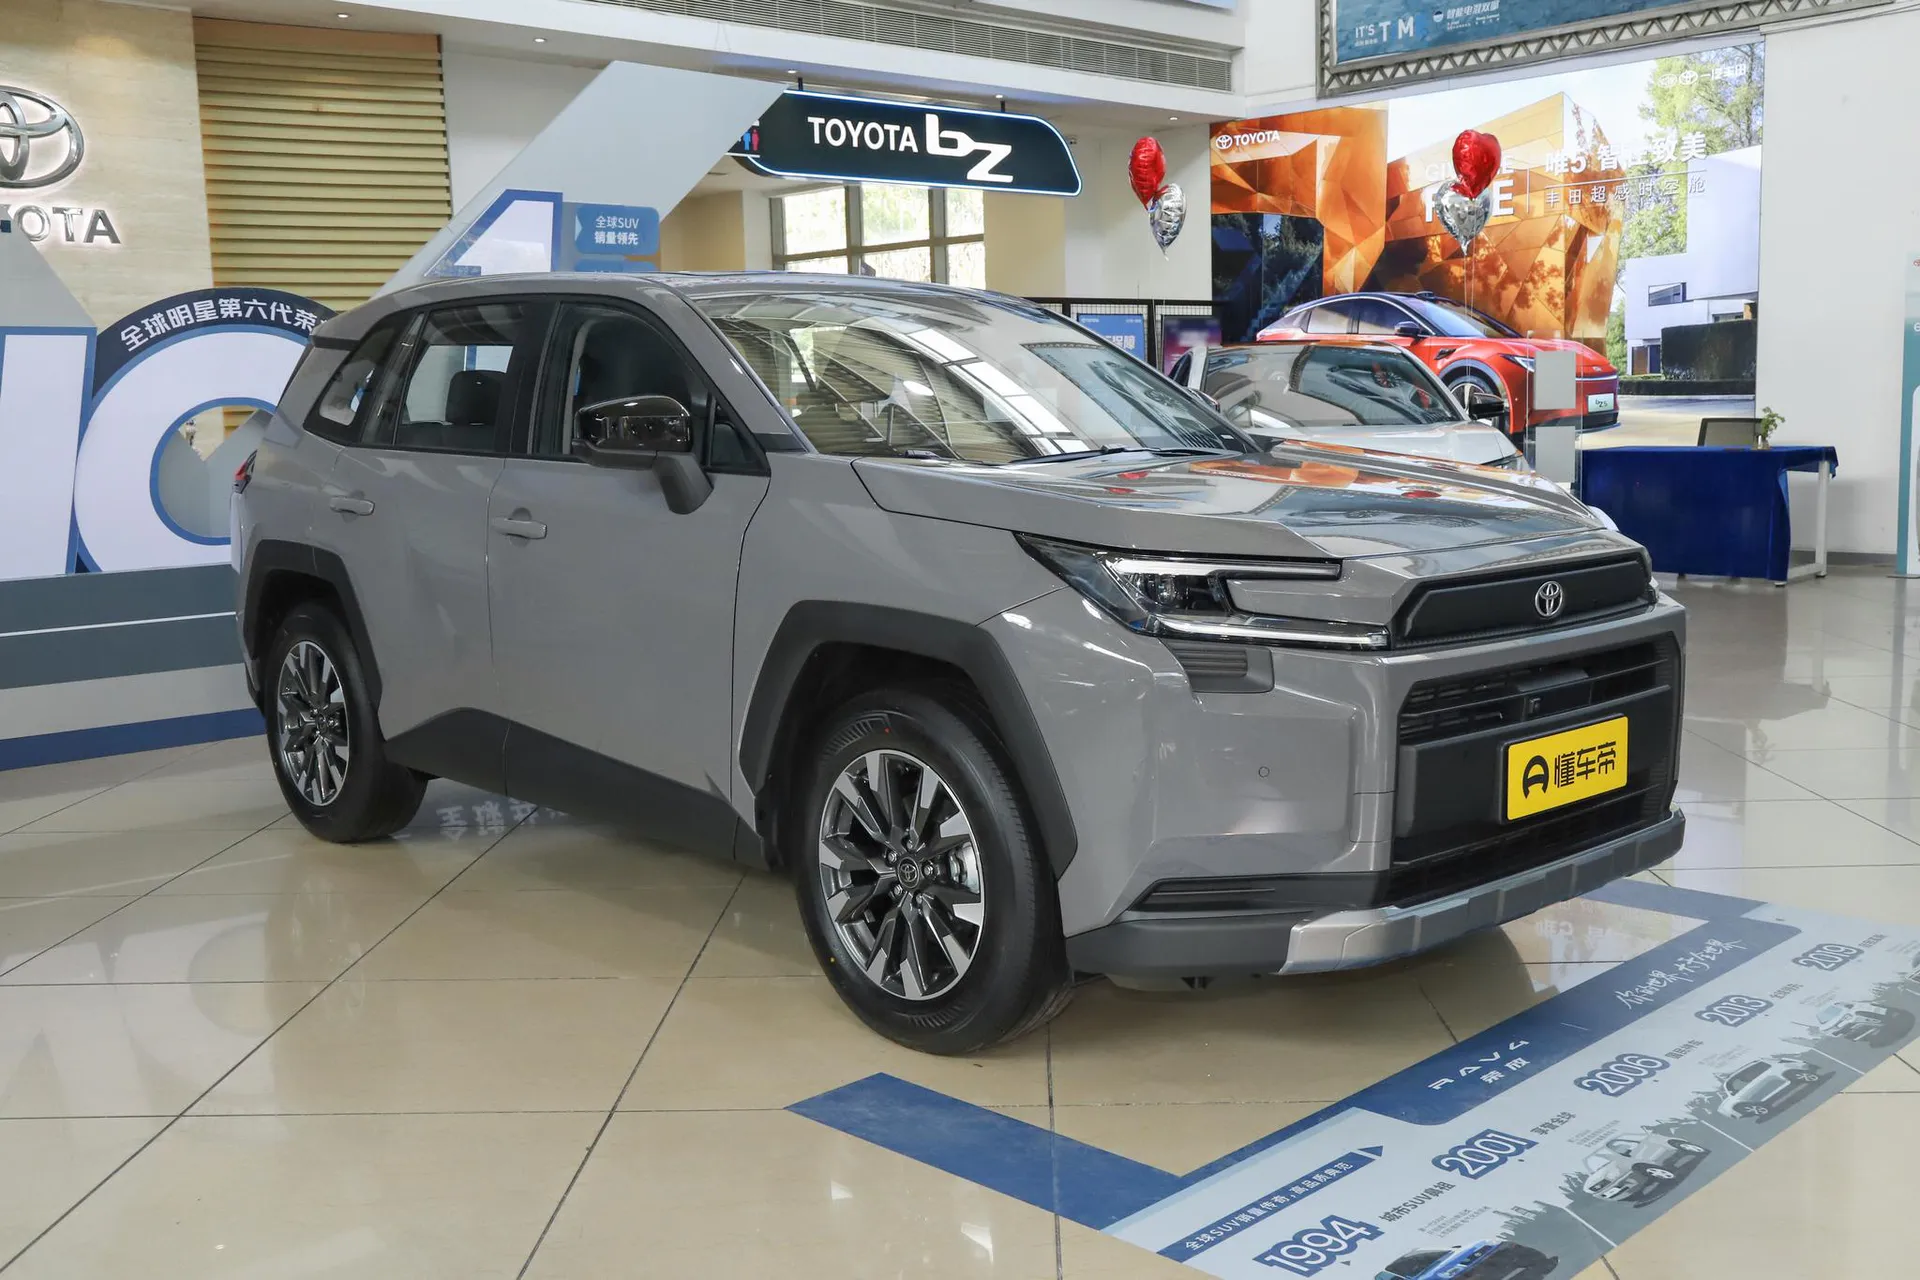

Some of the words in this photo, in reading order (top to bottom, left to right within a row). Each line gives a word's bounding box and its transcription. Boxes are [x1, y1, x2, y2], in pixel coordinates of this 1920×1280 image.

[1355, 23, 1376, 39] IT'S
[808, 116, 919, 153] TOYOTA
[1233, 130, 1281, 147] TOYOTA
[594, 230, 639, 246] 销量领先
[595, 215, 640, 230] 全球SUV
[120, 297, 328, 352] 全球明星第六代荣
[1554, 741, 1617, 788] 懂车帝
[1797, 944, 1858, 970] 2019
[1701, 995, 1768, 1026] 2013
[1427, 1039, 1530, 1091] RAV4
[1480, 1057, 1531, 1084] 荣放
[1581, 1054, 1664, 1094] 2006
[1440, 1132, 1529, 1176] 2001
[1264, 1219, 1373, 1272] 1994
